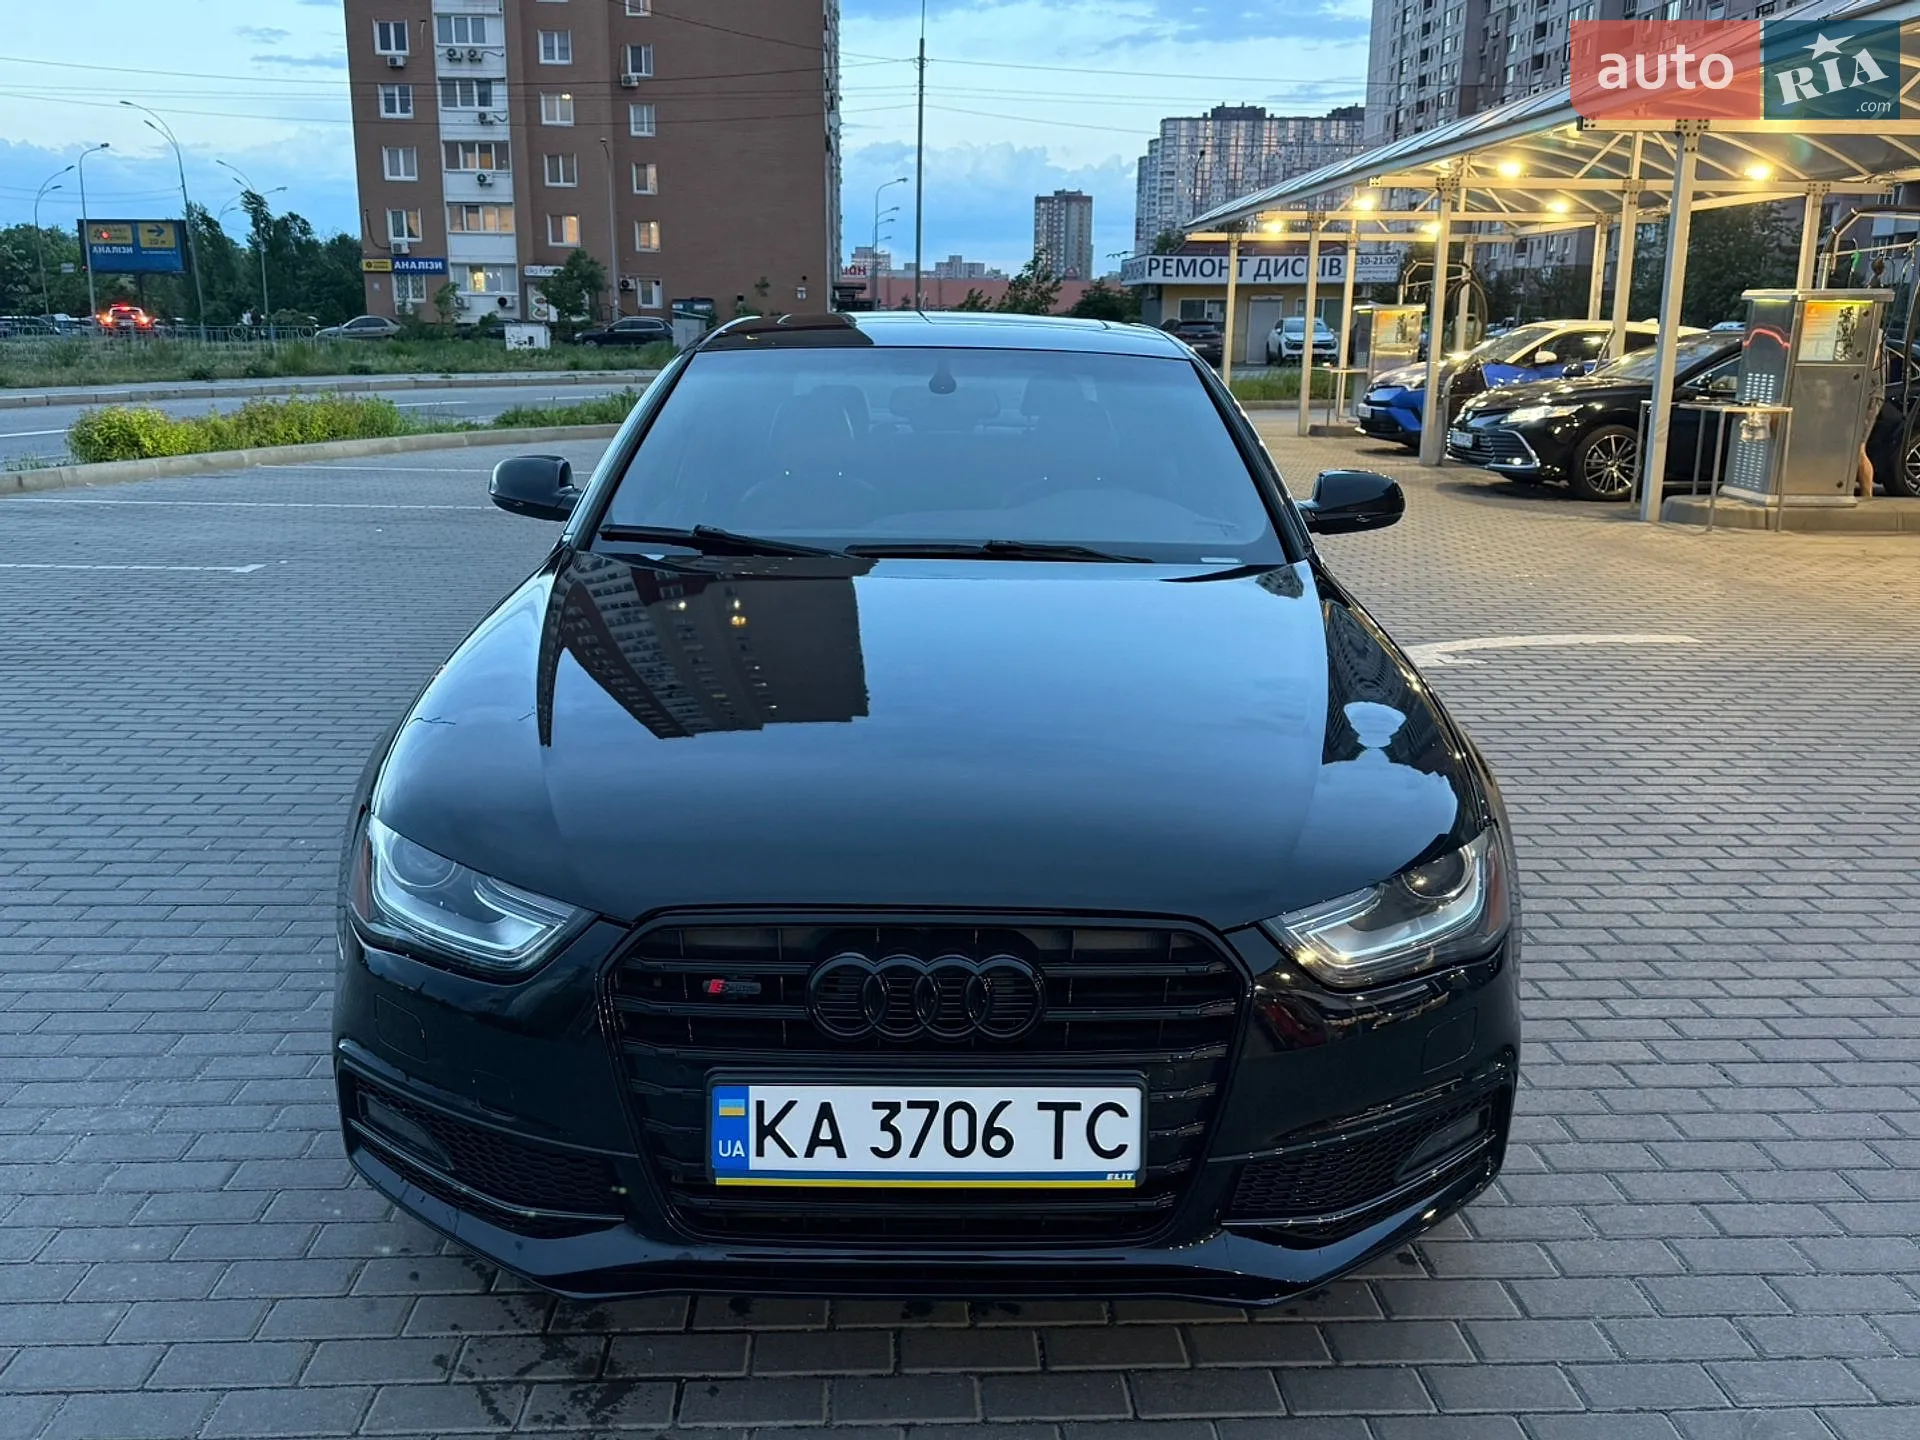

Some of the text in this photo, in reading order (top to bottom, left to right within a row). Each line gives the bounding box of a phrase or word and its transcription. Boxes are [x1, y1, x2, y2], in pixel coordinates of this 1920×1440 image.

[92, 246, 133, 254] АНАЛІЗИ
[394, 260, 443, 270] АНАЛІЗИ
[1147, 257, 1249, 278] РЕМОНТ
[1253, 257, 1342, 281] ДИСІВ
[755, 1100, 1129, 1160] KA 3706 TC
[718, 1139, 745, 1157] UA
